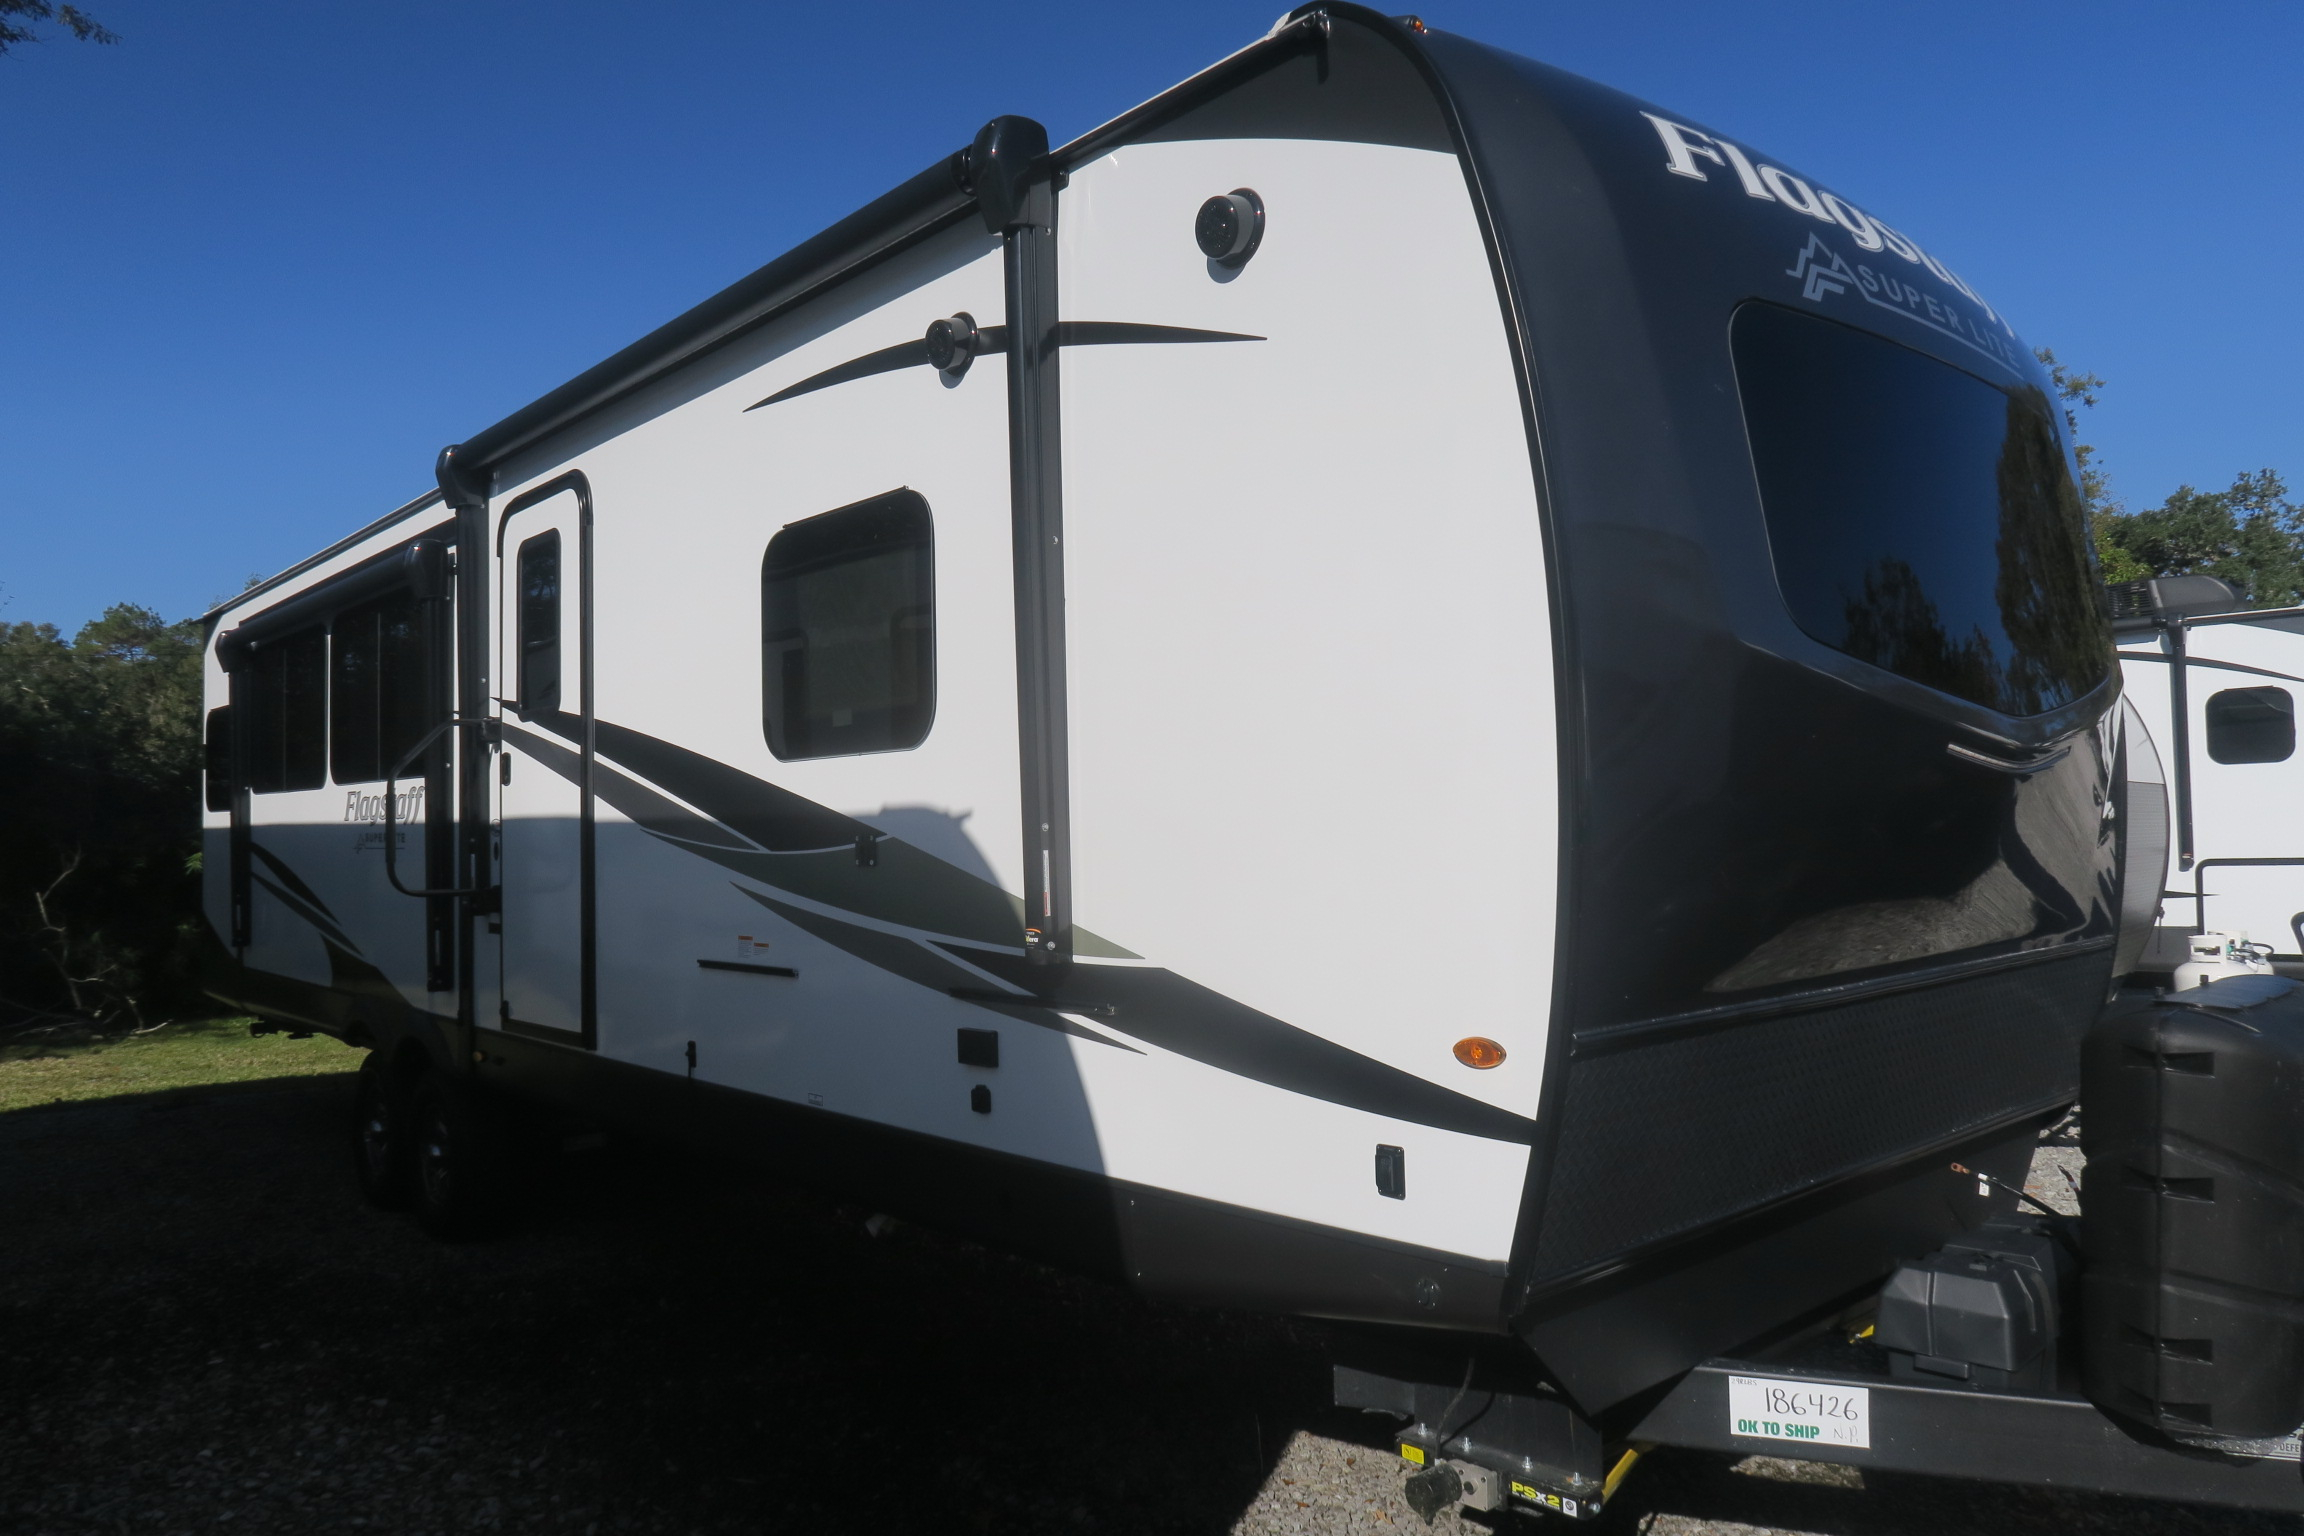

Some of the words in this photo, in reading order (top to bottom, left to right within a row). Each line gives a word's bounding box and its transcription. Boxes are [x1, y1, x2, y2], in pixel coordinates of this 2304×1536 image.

[1857, 264, 1964, 333] SUPER
[1969, 318, 2020, 369] LITE
[344, 785, 426, 827] Flagsaff
[1765, 1387, 1858, 1421] 186426
[1737, 1418, 1758, 1434] OK
[1761, 1421, 1780, 1436] TO
[1784, 1423, 1820, 1439] SHIP
